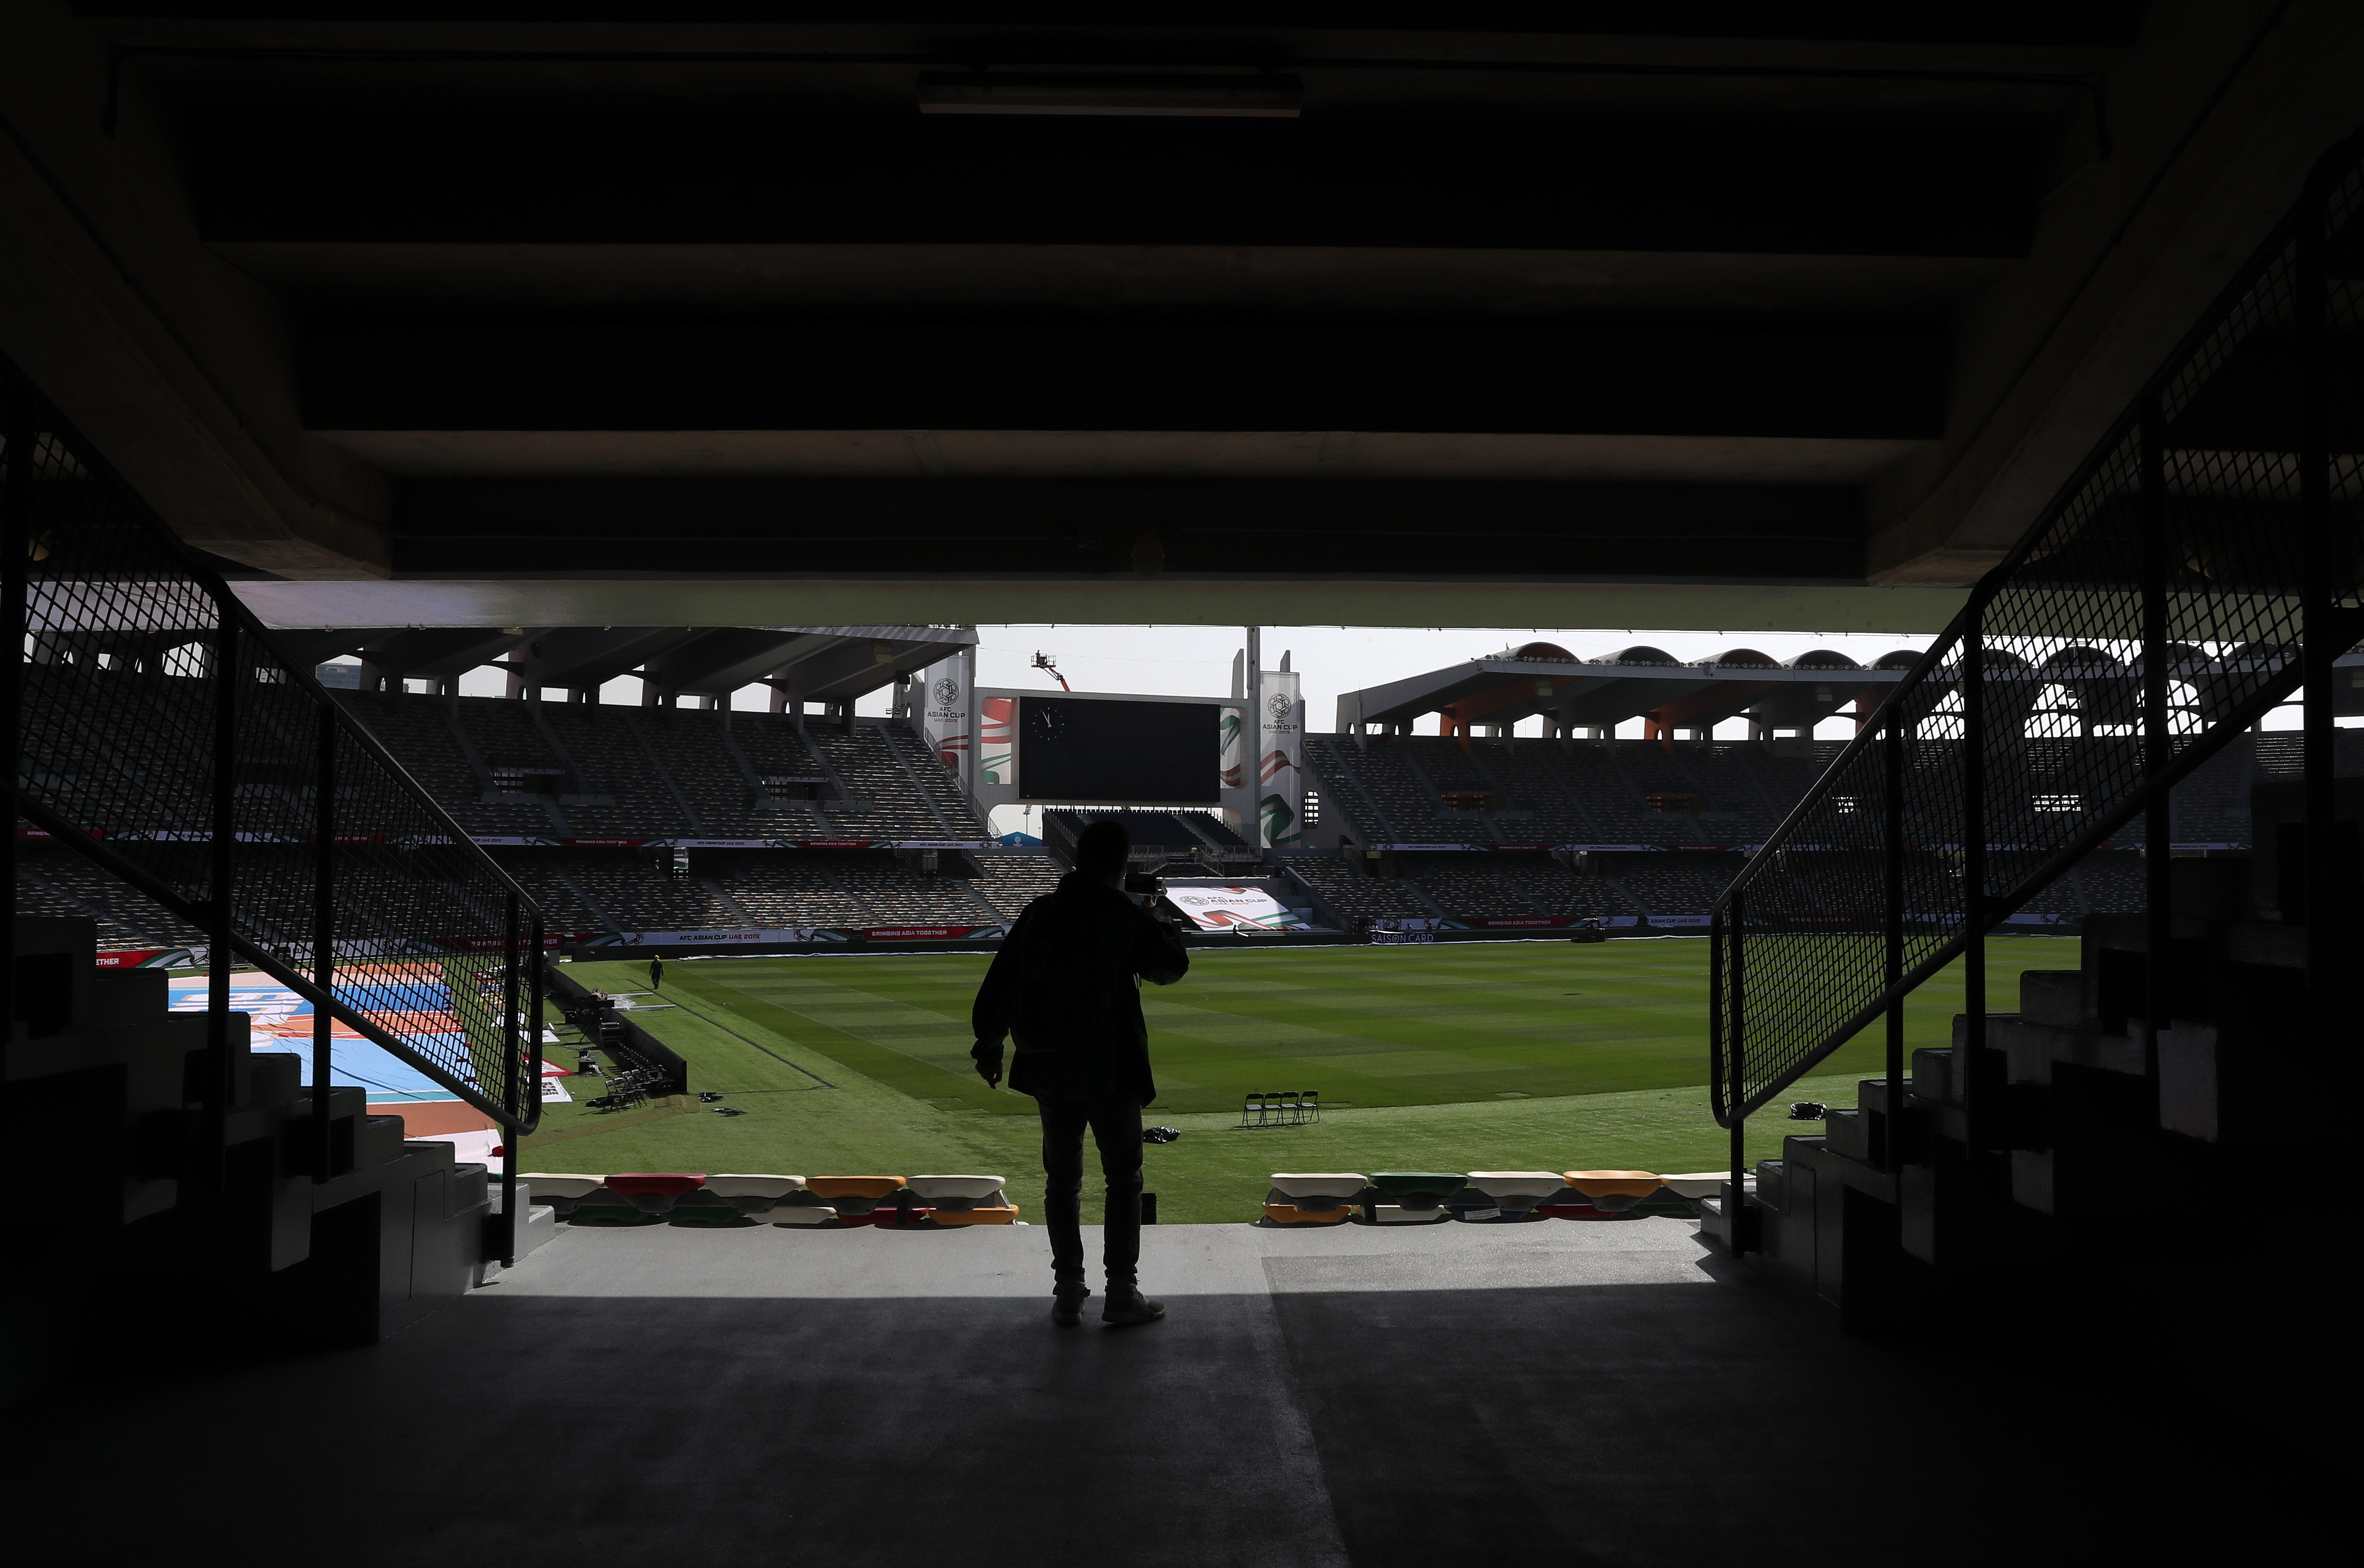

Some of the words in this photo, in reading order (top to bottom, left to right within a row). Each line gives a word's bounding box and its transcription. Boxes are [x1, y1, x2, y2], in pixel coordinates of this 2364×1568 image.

[1371, 934, 1406, 943] SAISON
[1408, 934, 1434, 943] CARD
[96, 958, 120, 966] ETHER
